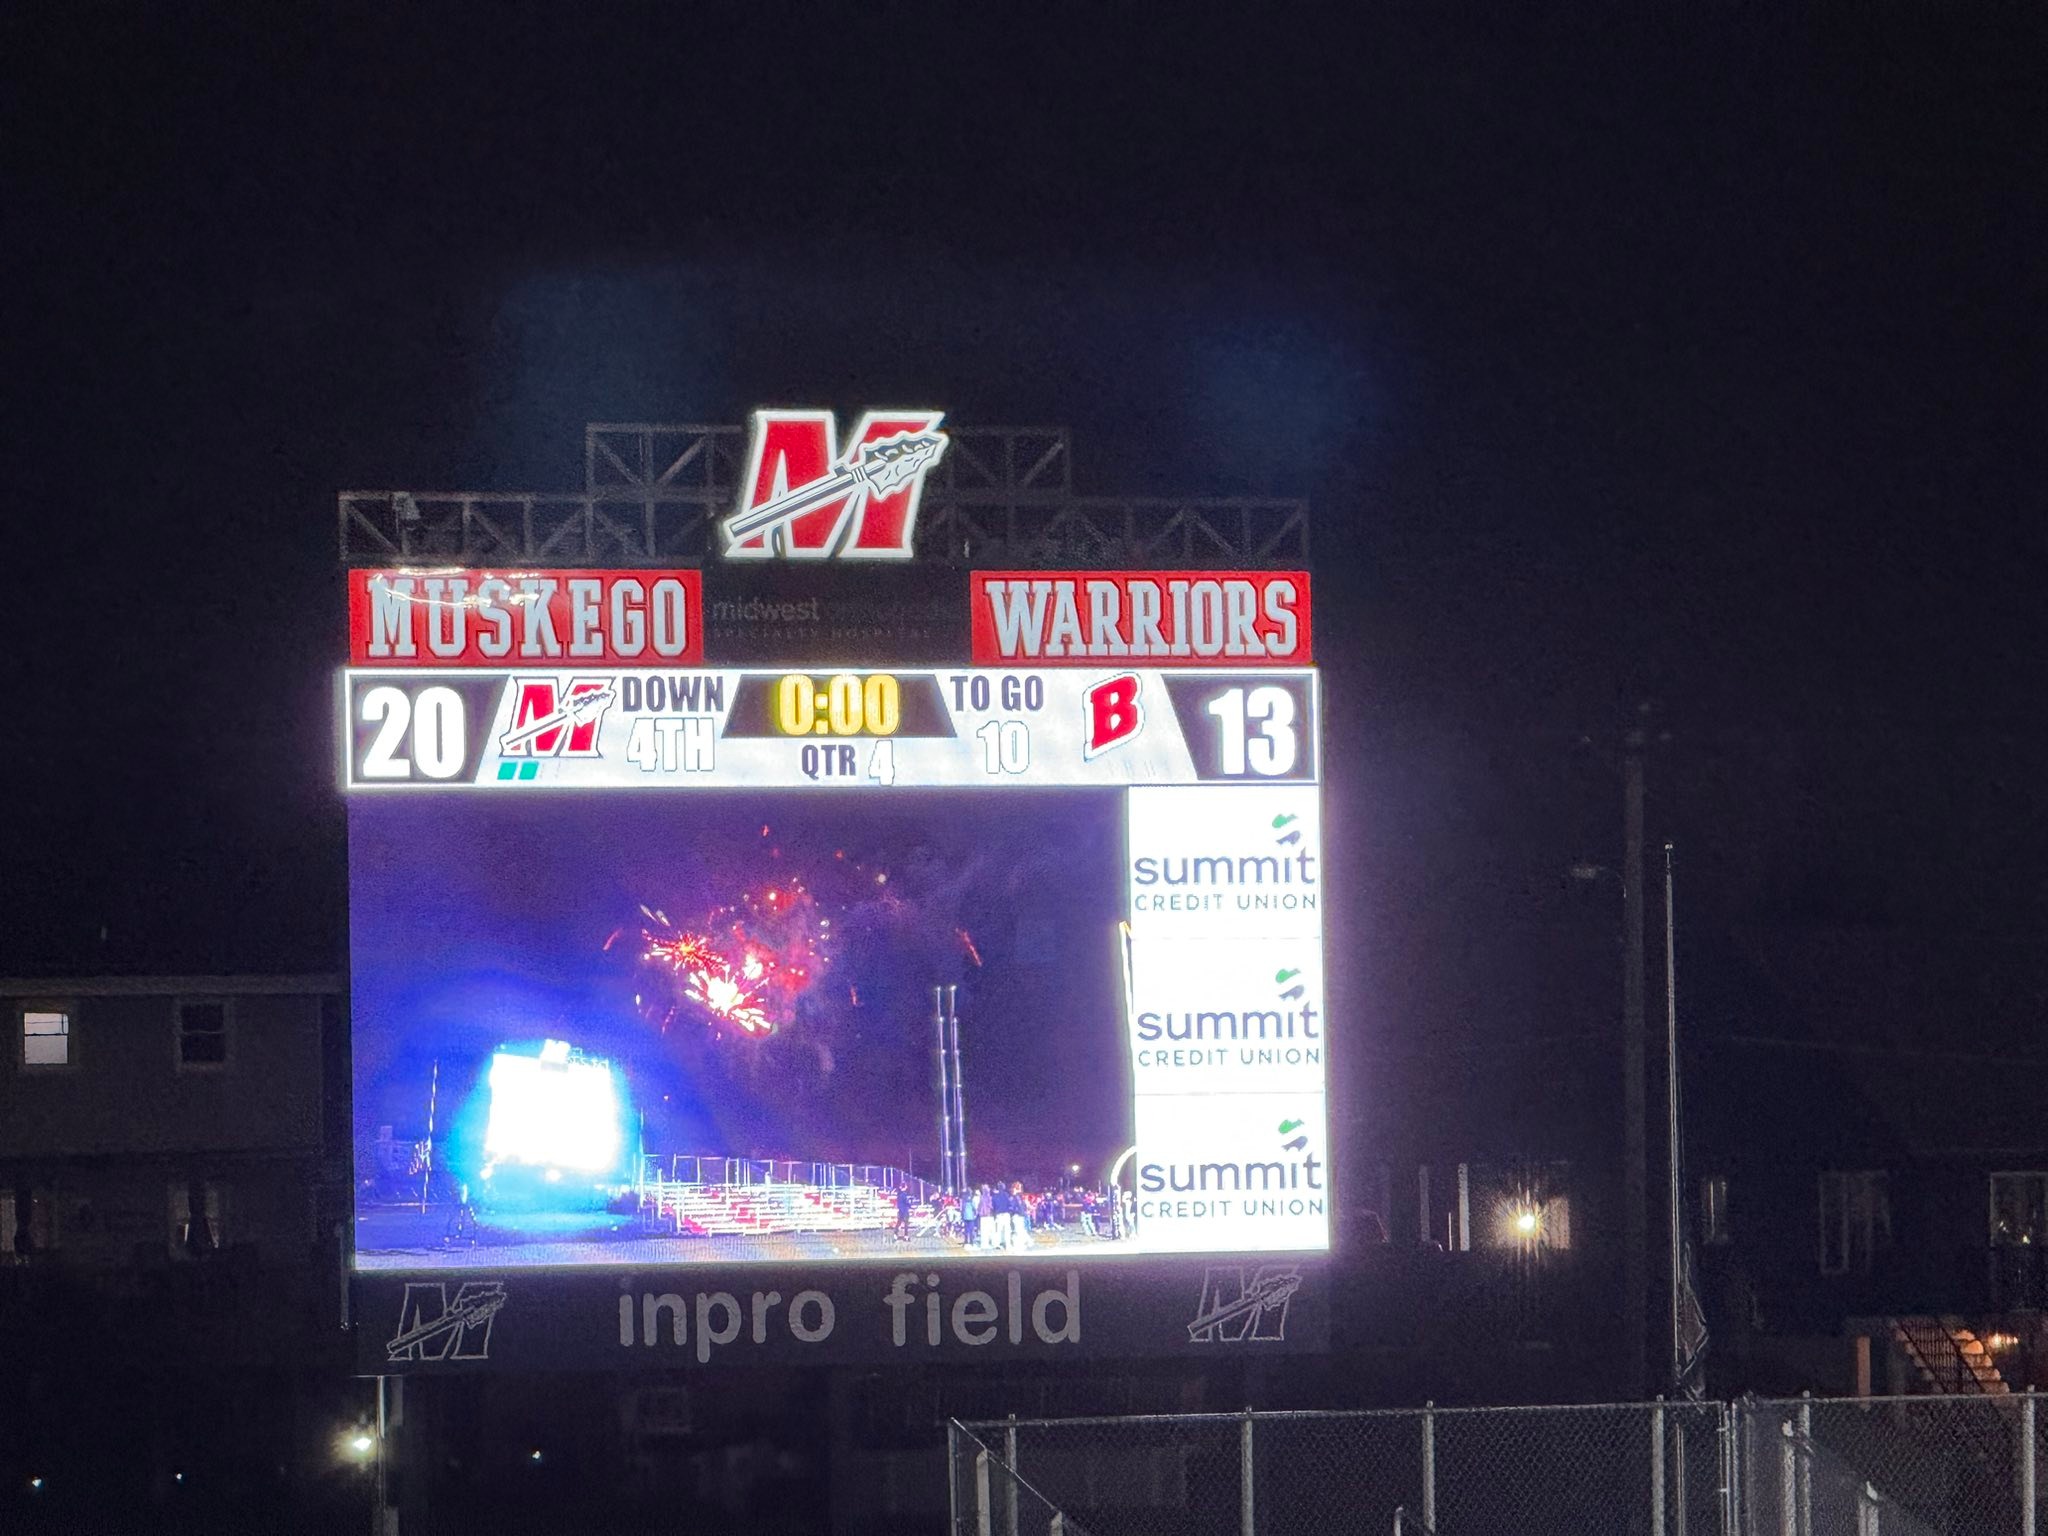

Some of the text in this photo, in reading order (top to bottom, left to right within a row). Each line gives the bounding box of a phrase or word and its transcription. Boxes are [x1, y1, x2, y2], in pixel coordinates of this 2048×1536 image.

[365, 575, 688, 658] MUSKEGO
[713, 596, 820, 621] midwest
[984, 579, 1297, 658] WARRIORS
[622, 675, 724, 712] DOWN
[779, 673, 900, 736] 0:00
[950, 675, 1044, 711] TO GO
[361, 686, 466, 778] 20
[1082, 672, 1145, 762] B
[1208, 687, 1296, 776] 13
[626, 717, 715, 772] 4TH
[801, 739, 895, 786] QTR 4
[976, 720, 1030, 774] 10
[1134, 847, 1315, 885] summit
[1135, 893, 1316, 911] CREDIT UNION
[1137, 1001, 1319, 1041] summit
[1138, 1048, 1320, 1067] CREDIT UNION
[1140, 1152, 1322, 1192] summit
[1141, 1199, 1323, 1218] CREDIT UNION
[618, 1270, 1082, 1363] inpro field
